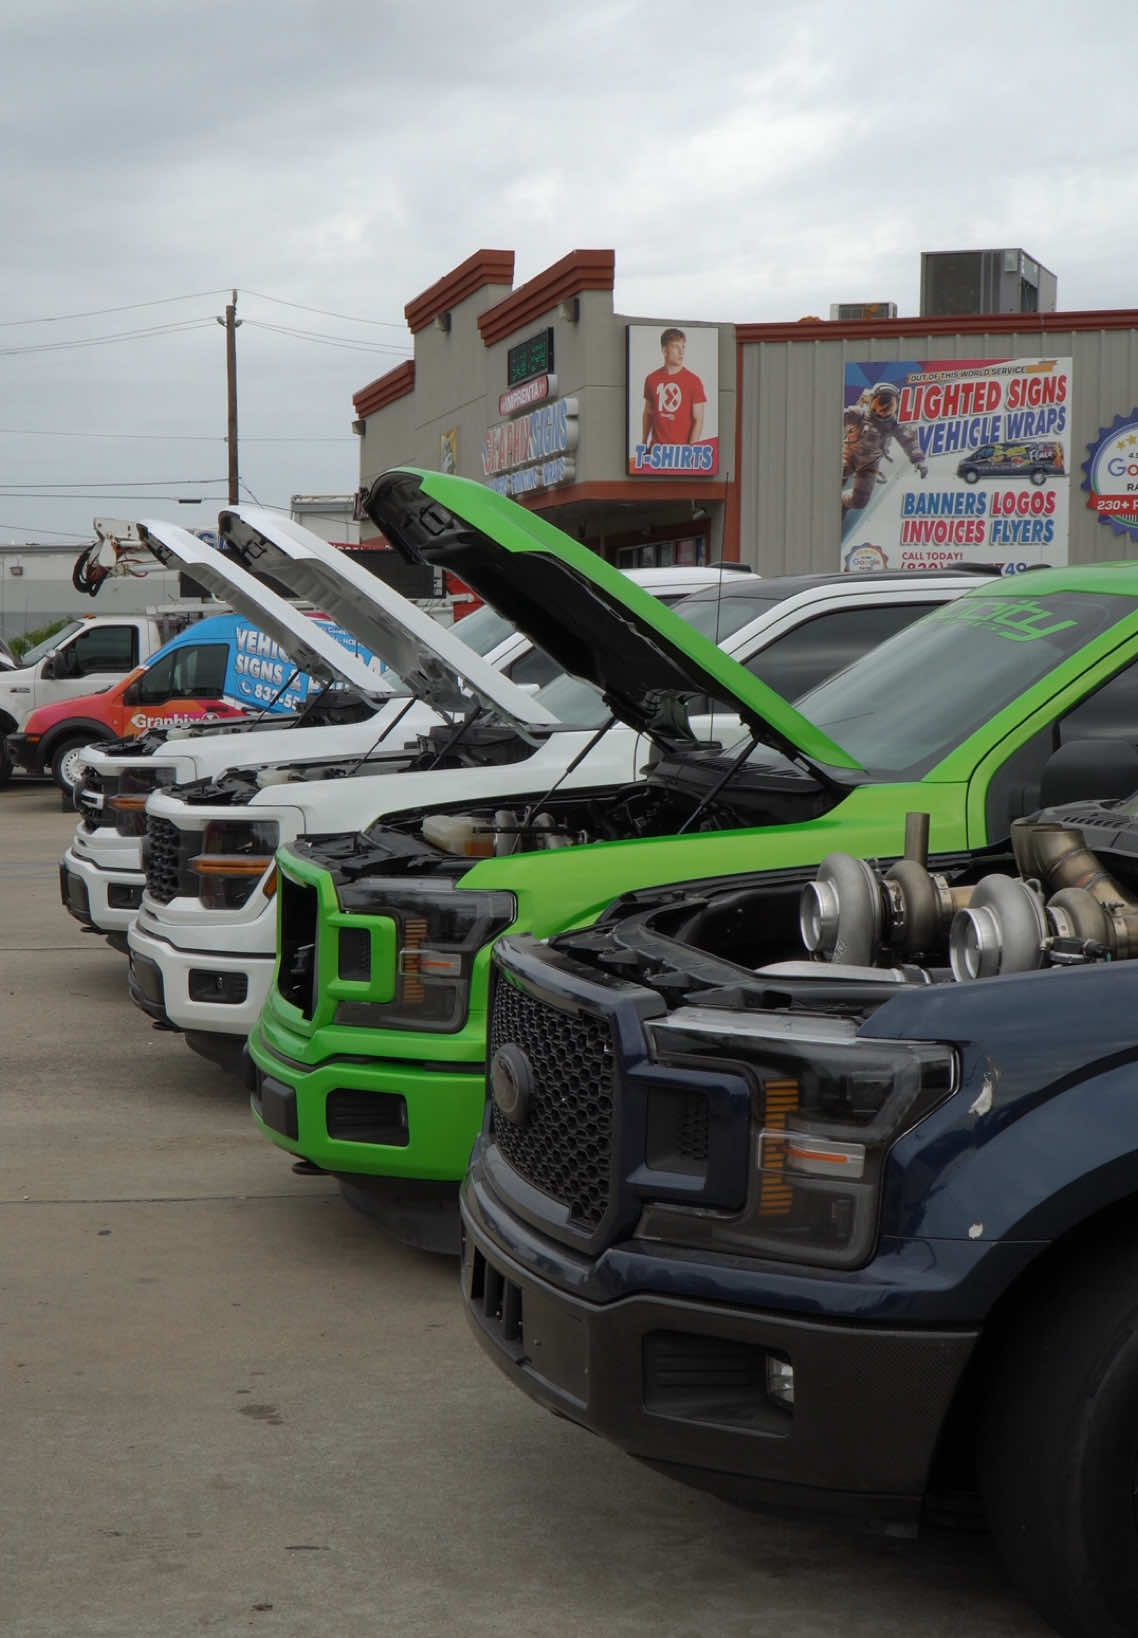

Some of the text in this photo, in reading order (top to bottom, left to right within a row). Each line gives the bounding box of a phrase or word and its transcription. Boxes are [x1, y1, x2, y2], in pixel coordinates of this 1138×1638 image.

[941, 372, 959, 380] THIS
[961, 369, 990, 377] WORLD
[991, 366, 1025, 376] SERVICE
[898, 375, 1067, 423] LIGHTED SIGNS
[918, 415, 1001, 455] VEHICLE
[1007, 406, 1067, 440] WRAPS
[636, 445, 714, 469] T-SHIRTS
[903, 491, 1056, 515] BANNERS LOGOS
[1097, 500, 1129, 511] 230+
[902, 520, 1055, 543] INVOICES FLYERS
[902, 552, 963, 560] CALL TODAY!
[235, 653, 283, 686] SIGNS
